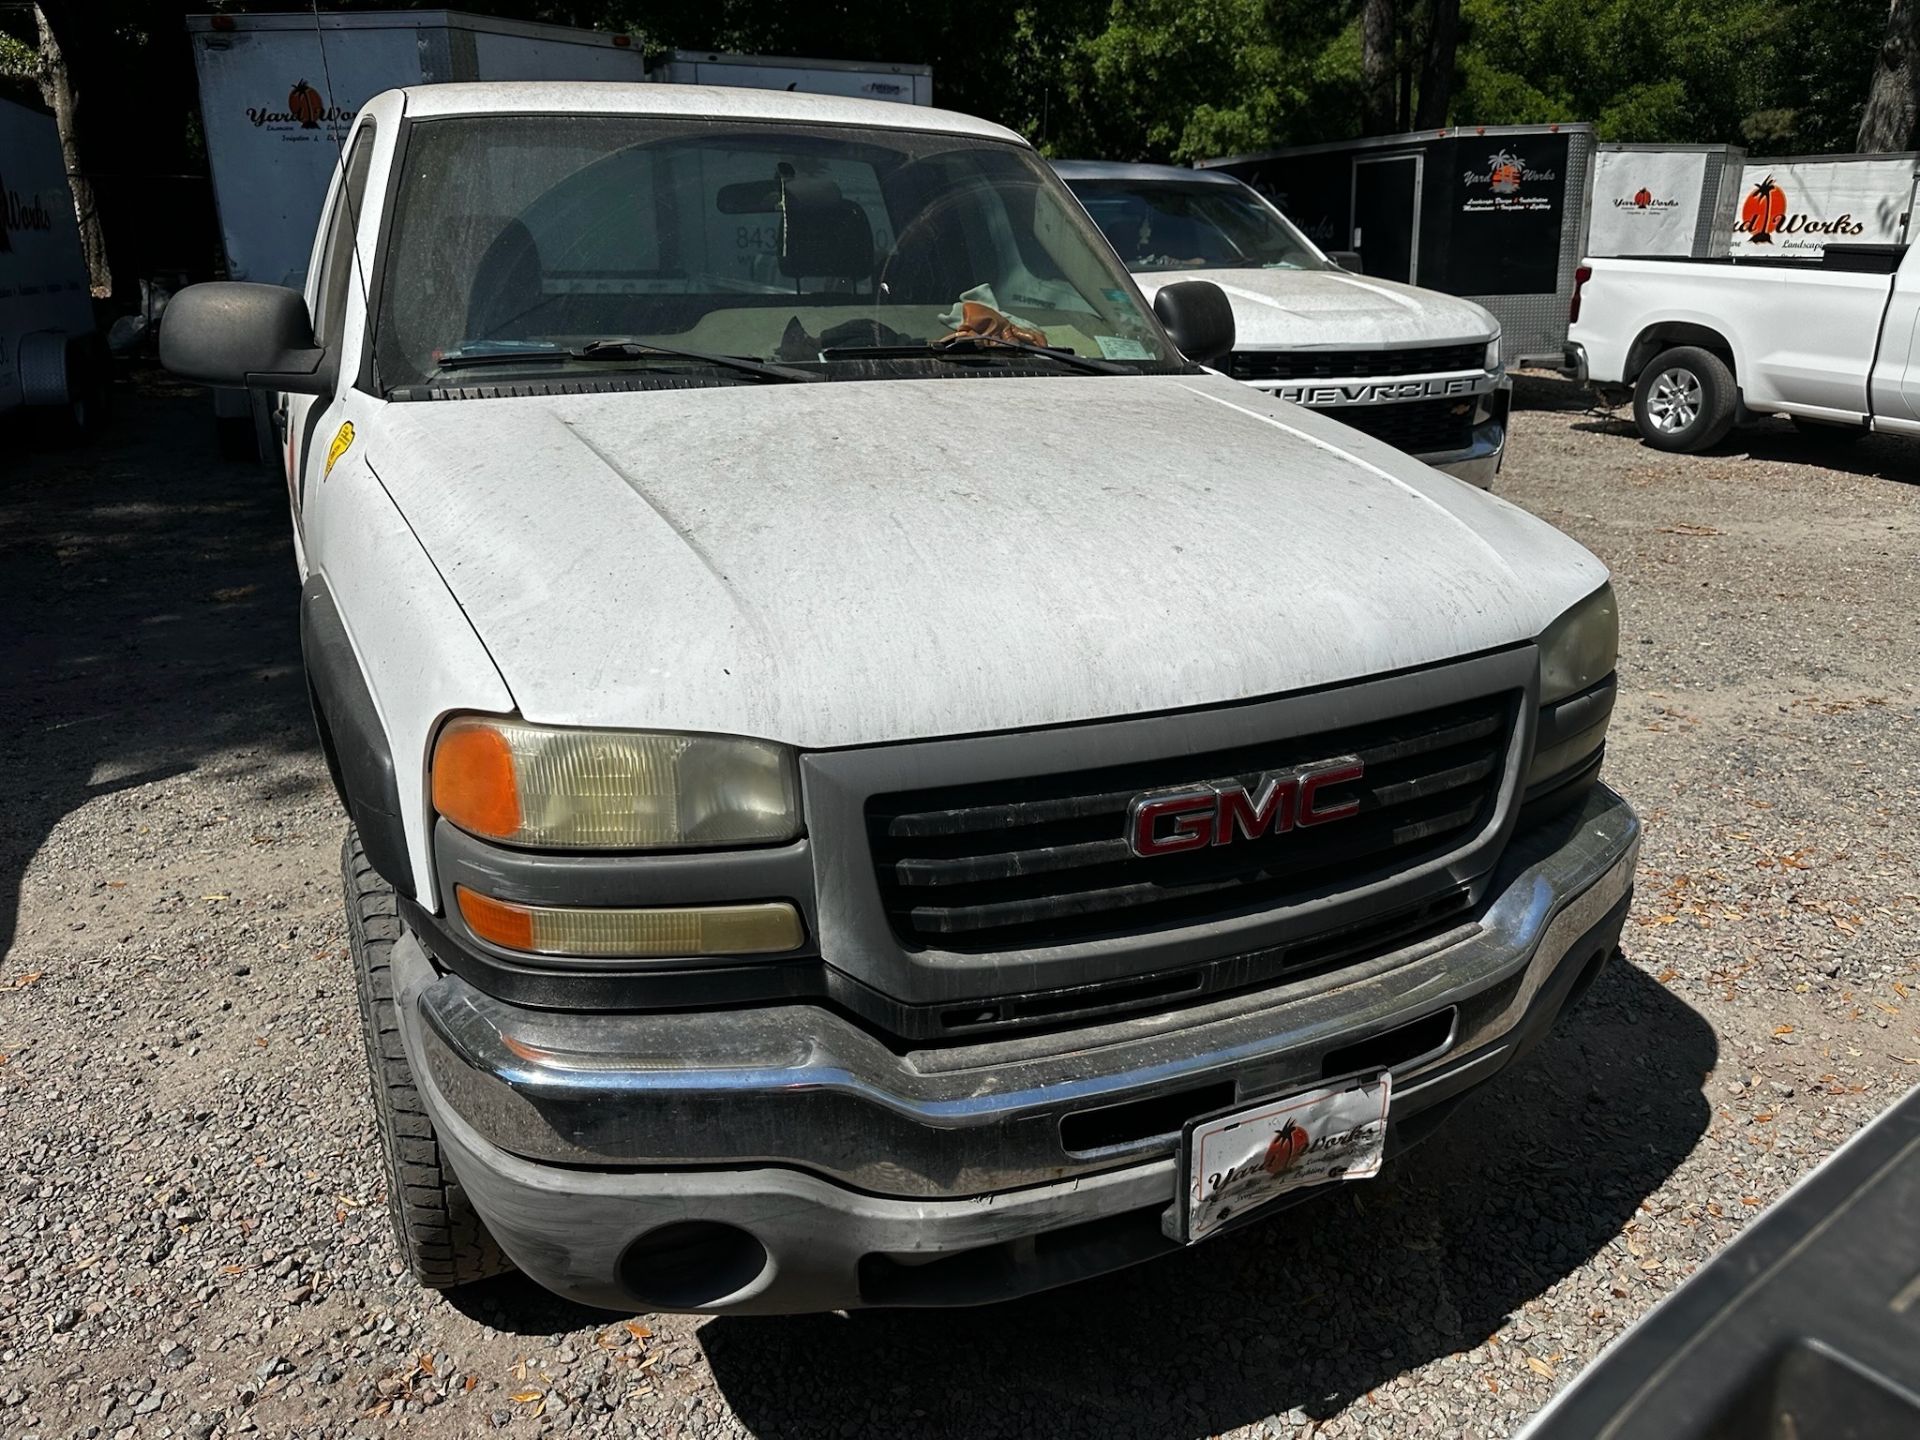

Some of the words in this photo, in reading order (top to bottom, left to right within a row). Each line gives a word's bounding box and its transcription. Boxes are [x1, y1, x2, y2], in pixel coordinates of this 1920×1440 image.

[1463, 170, 1493, 187] Yard
[1522, 168, 1555, 182] Works
[1773, 213, 1864, 236] Works
[1781, 239, 1825, 252] Landscapi
[1127, 753, 1365, 858] GMC
